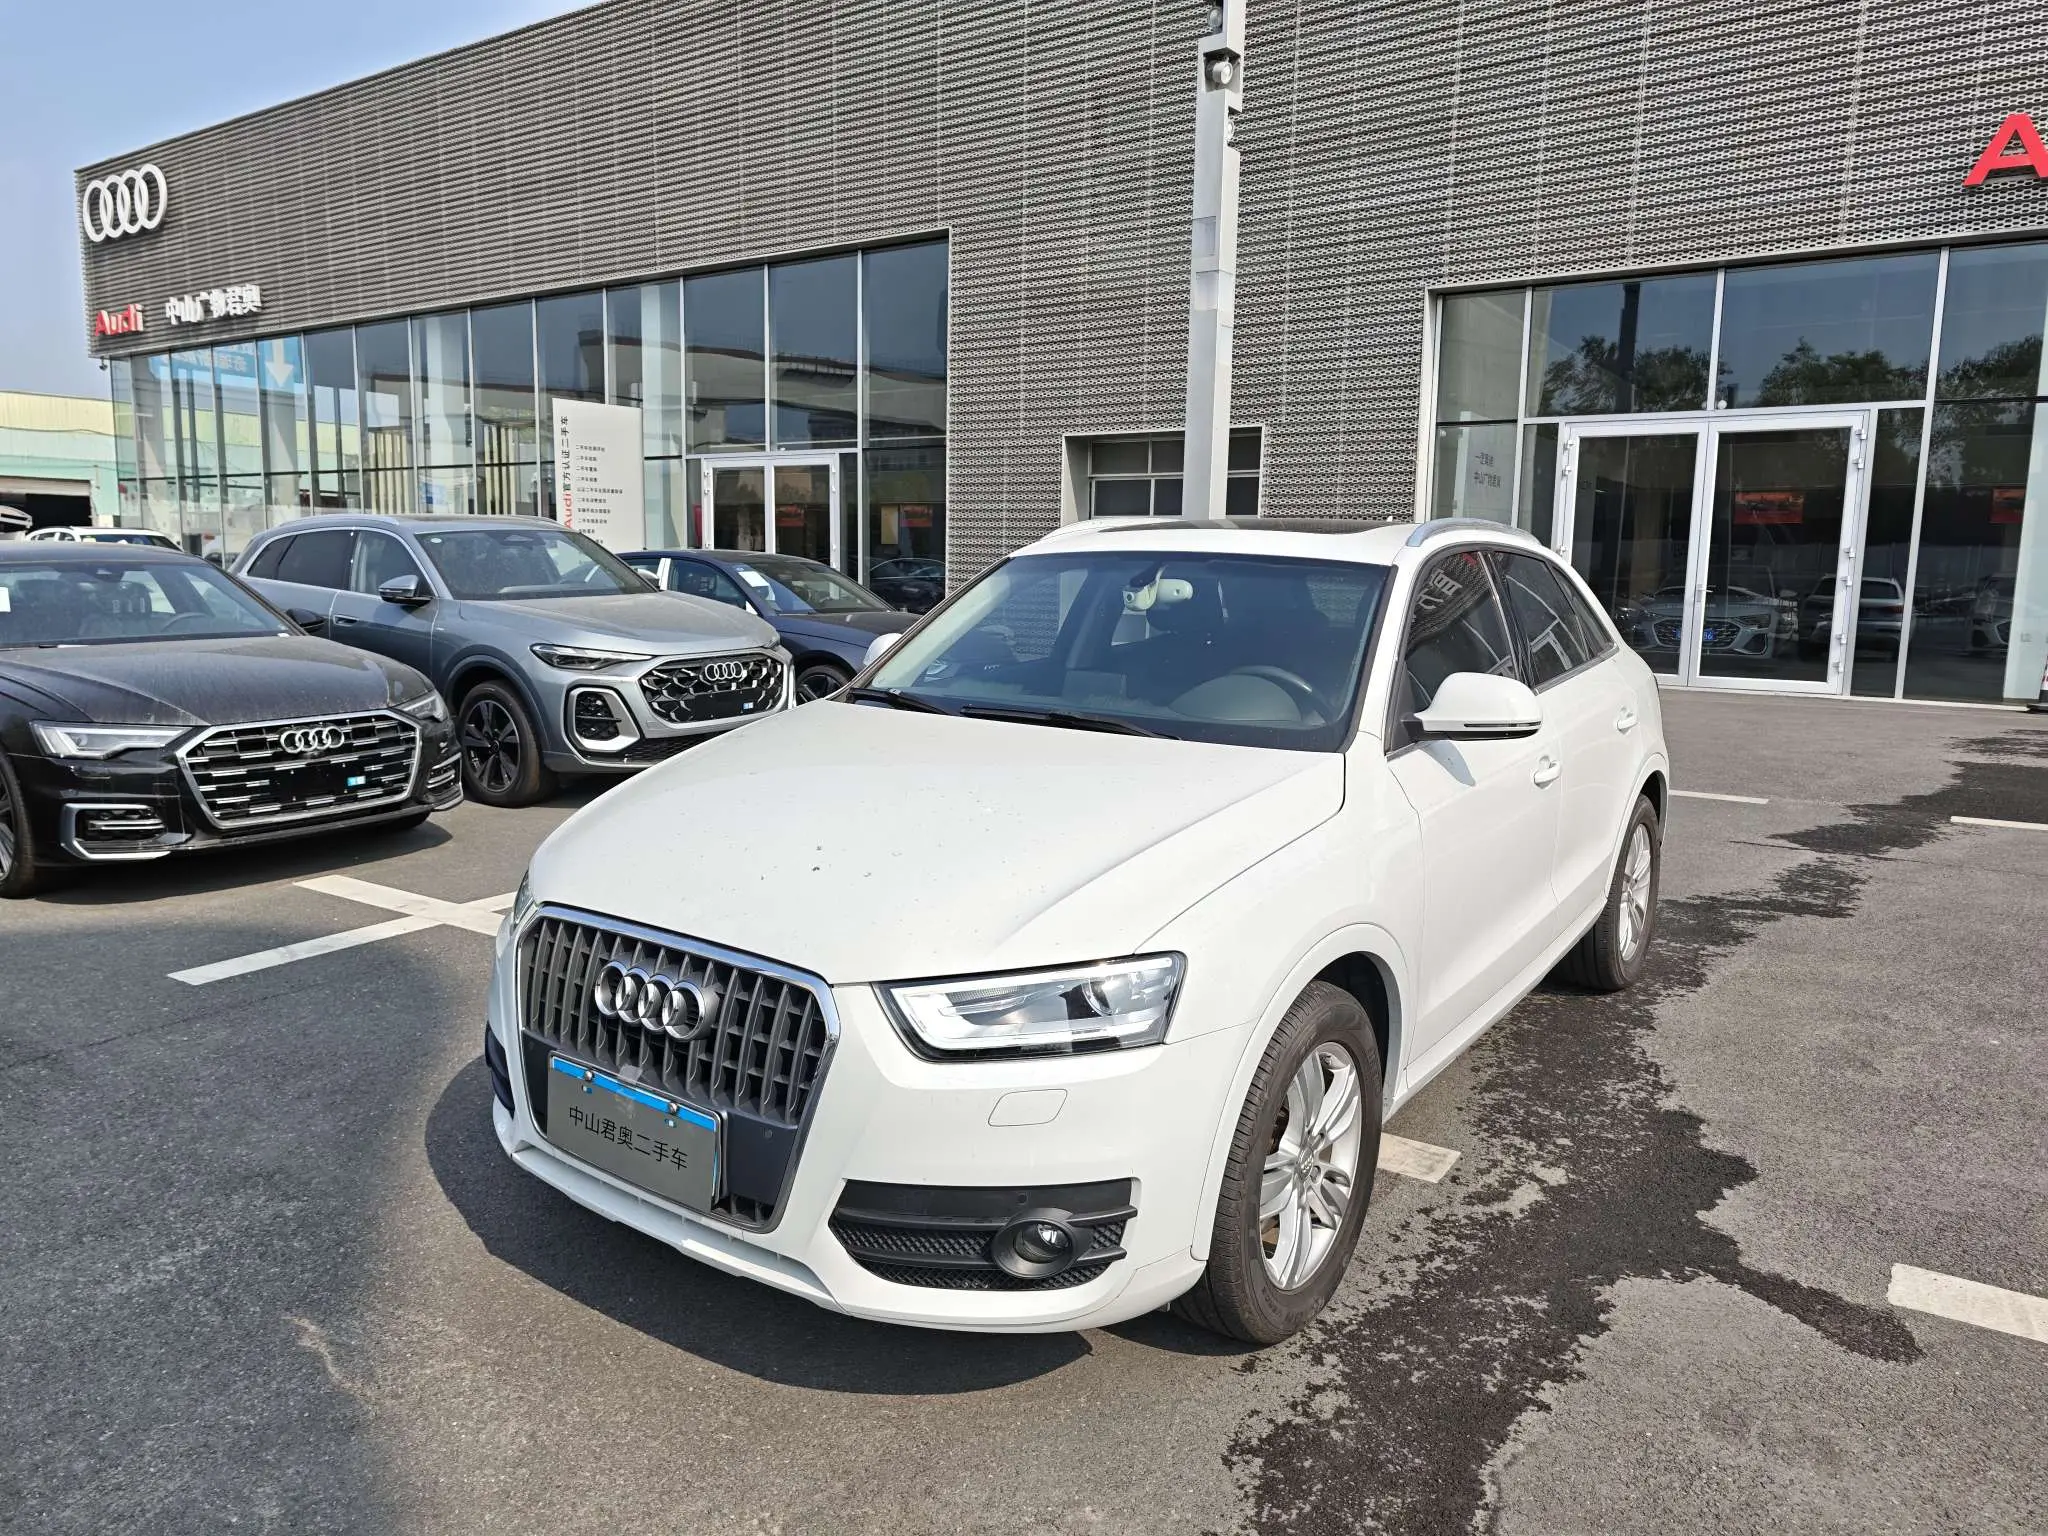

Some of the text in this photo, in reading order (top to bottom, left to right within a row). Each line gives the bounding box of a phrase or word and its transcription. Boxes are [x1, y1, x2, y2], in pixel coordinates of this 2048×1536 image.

[1962, 112, 2048, 187] A
[95, 303, 144, 337] Audi
[569, 1105, 688, 1171] 中山君奥二手车
